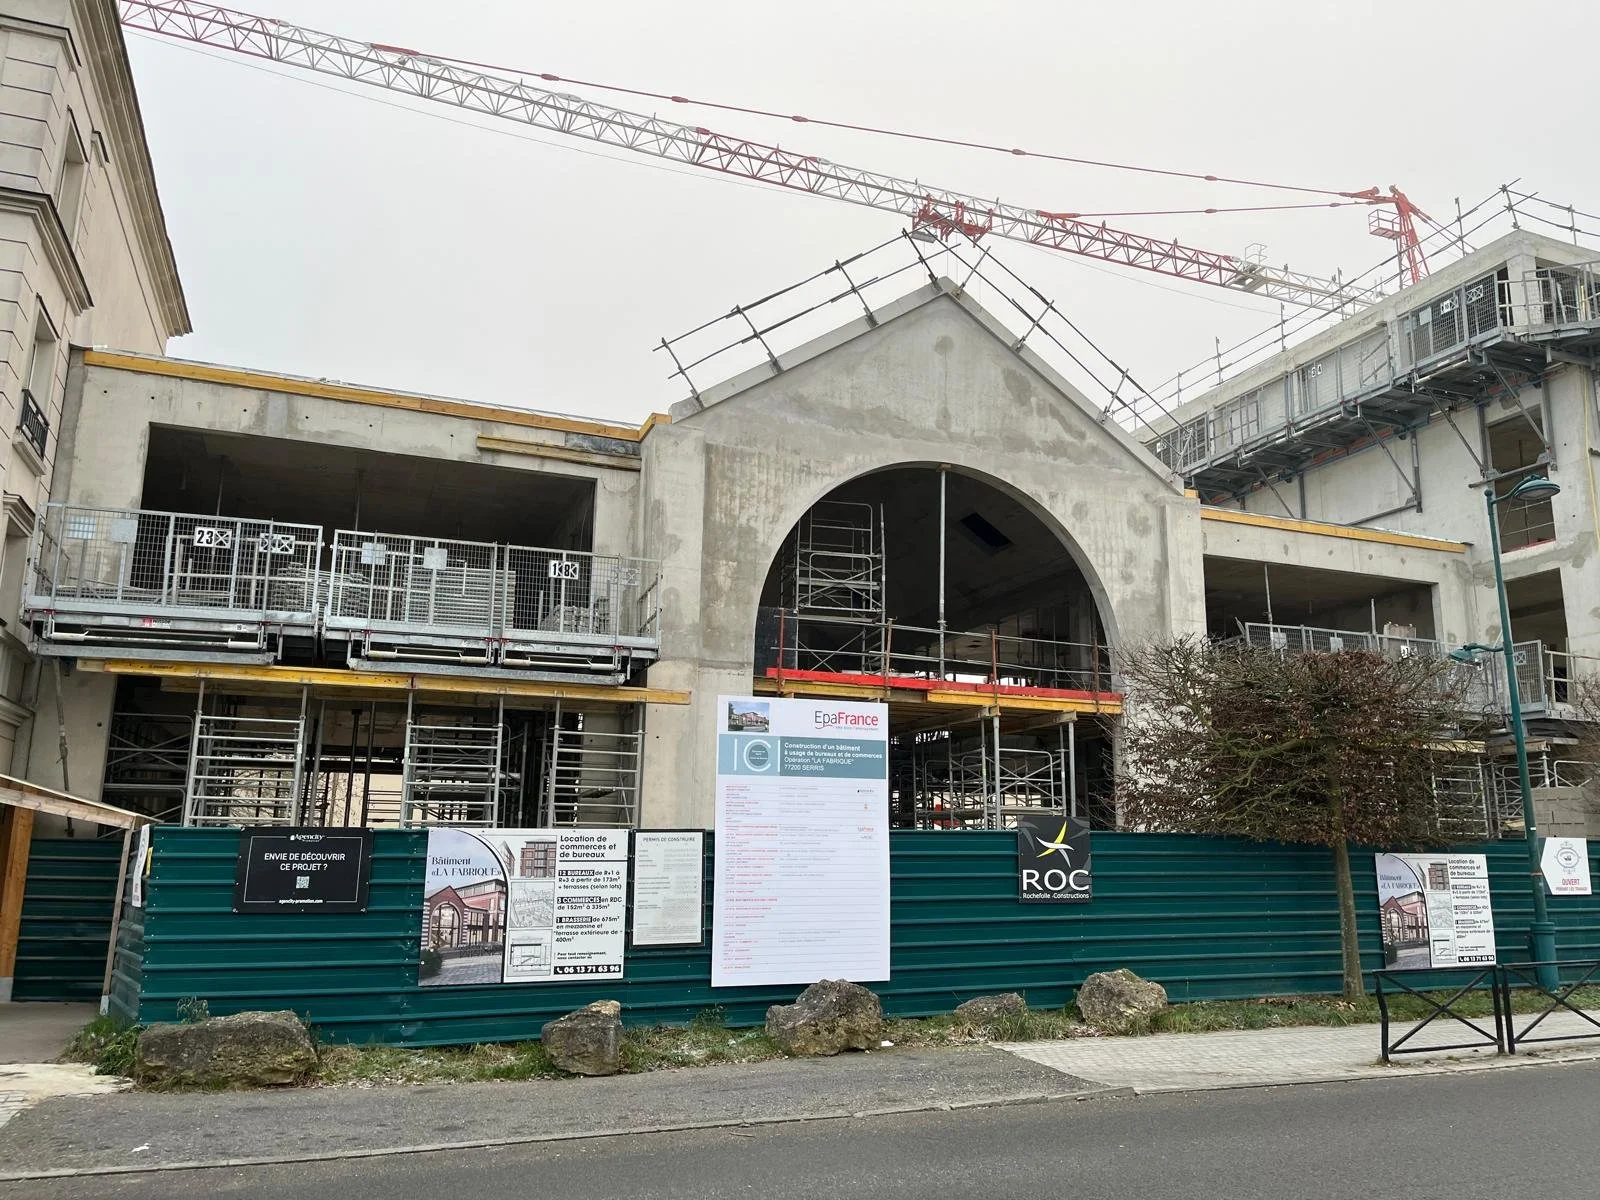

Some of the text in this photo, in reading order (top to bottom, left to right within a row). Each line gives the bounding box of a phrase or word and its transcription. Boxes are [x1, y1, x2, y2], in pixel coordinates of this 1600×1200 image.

[815, 711, 878, 726] EpaFrance
[784, 757, 810, 765] Opération
[301, 852, 345, 860] DÉCOUVRIR
[432, 857, 471, 865] Bâtiment
[280, 863, 292, 871] CE
[292, 863, 321, 871] PROJET
[1023, 869, 1089, 891] ROC
